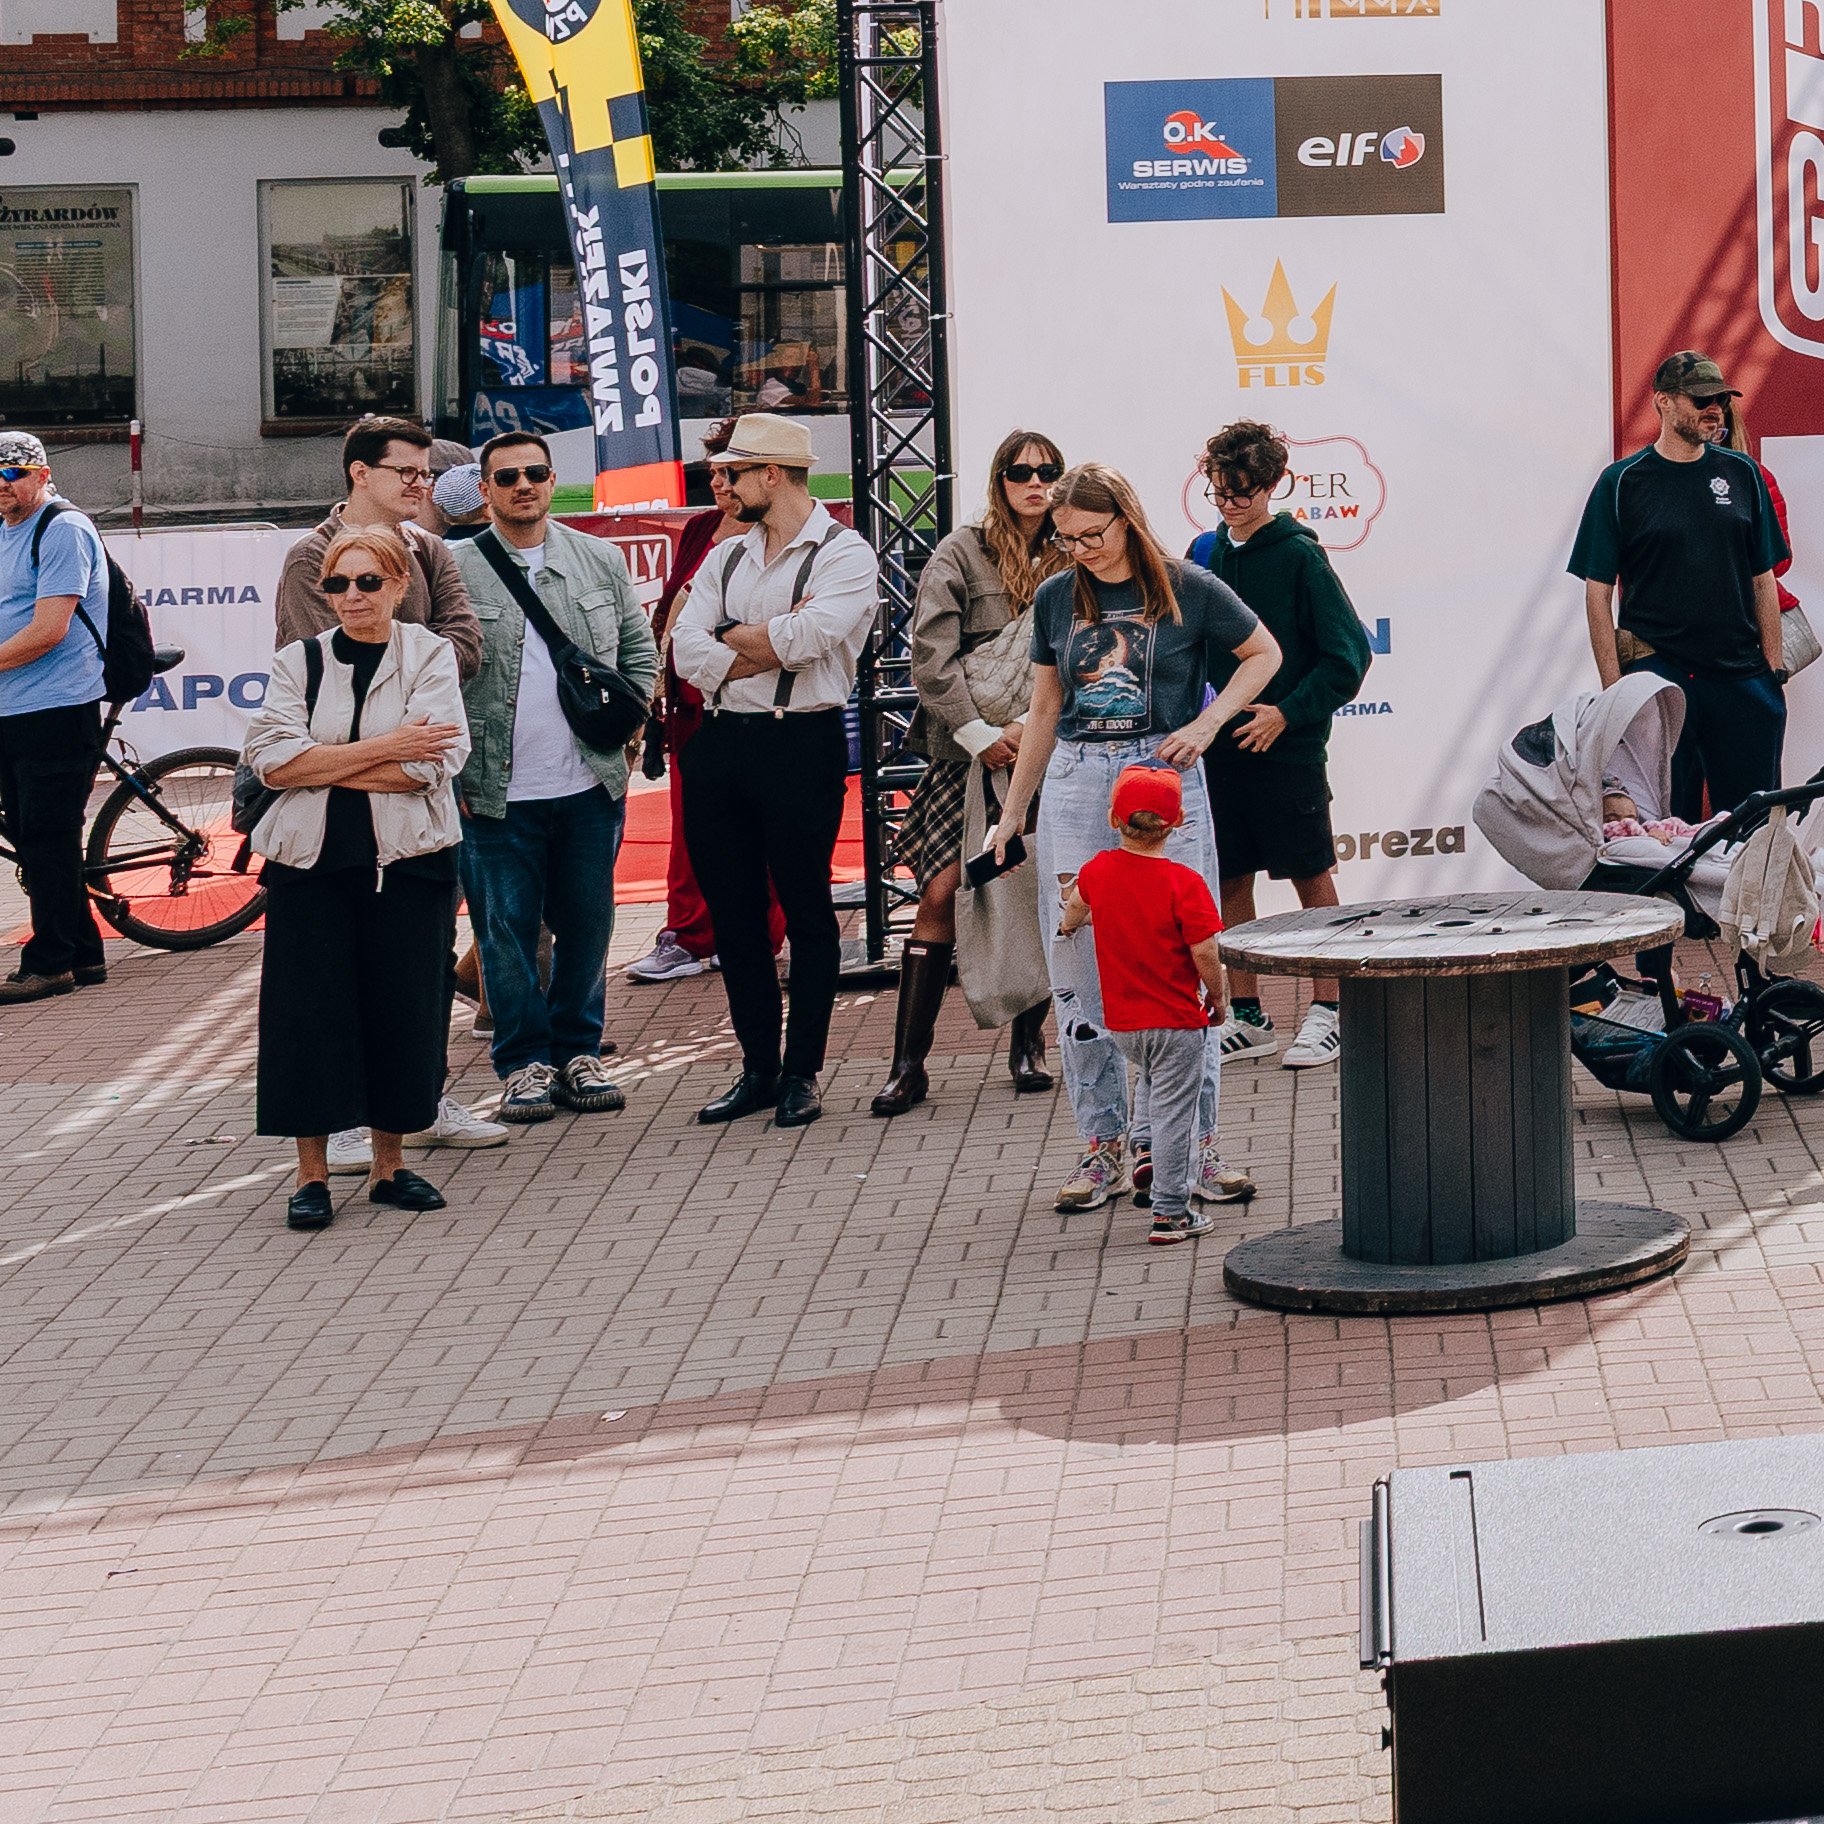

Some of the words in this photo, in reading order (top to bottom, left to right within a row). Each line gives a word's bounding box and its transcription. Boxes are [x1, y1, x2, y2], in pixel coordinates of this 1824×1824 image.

[1297, 131, 1379, 167] elf
[1133, 157, 1249, 179] SERWIS
[1118, 179, 1178, 190] Warsztaty
[1180, 179, 1215, 189] godne
[1238, 364, 1327, 388] FLIS
[1279, 504, 1360, 521] ABAW
[138, 585, 262, 607] HARMA
[131, 672, 272, 713] APO
[1332, 825, 1466, 875] preza
